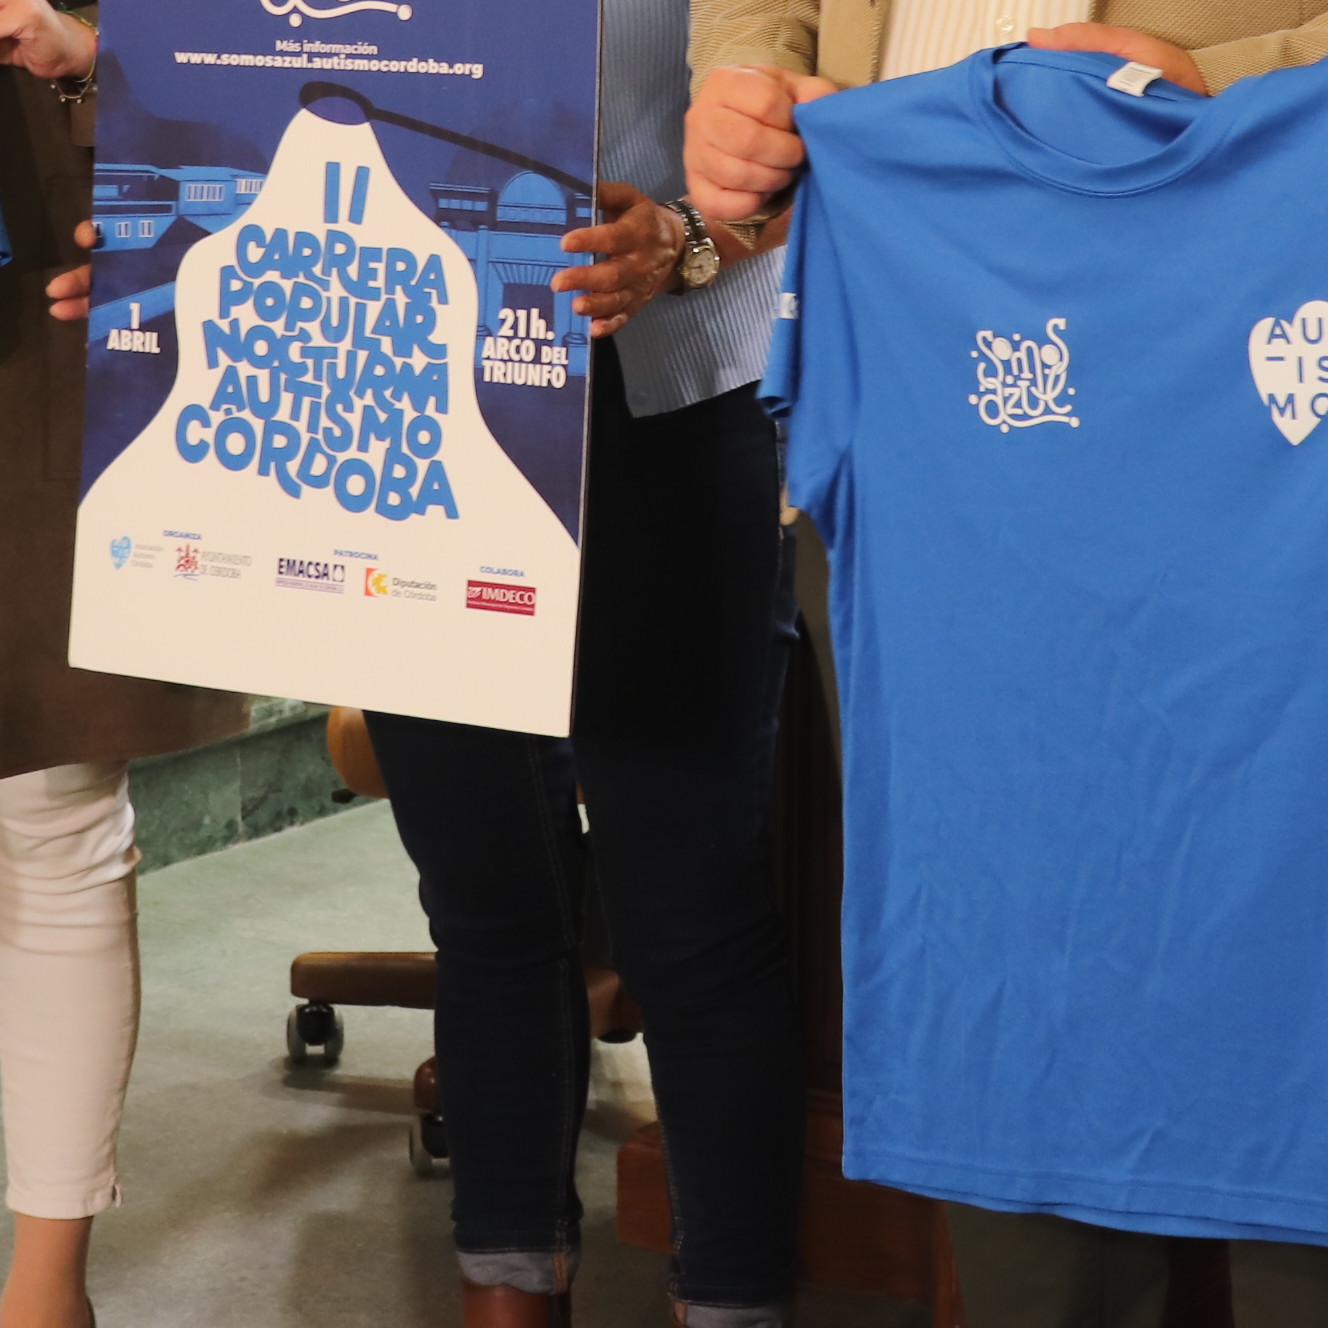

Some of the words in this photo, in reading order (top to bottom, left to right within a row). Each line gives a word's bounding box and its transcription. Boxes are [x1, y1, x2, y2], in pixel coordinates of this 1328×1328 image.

[275, 40, 302, 53] Más
[303, 40, 378, 55] información
[174, 50, 484, 79] www.somosazul.autismocordoba.org
[324, 161, 370, 224] II
[236, 224, 449, 305] CARRERA
[128, 302, 141, 329] 1
[219, 265, 447, 360] POPULAR
[497, 307, 556, 341] 21h.
[106, 328, 161, 354] ABRIL
[1266, 317, 1322, 345] AU
[481, 336, 536, 362] ARCO
[540, 345, 569, 365] DEL
[202, 318, 449, 414] NOCTURNA
[481, 359, 567, 389] TRIUNFO
[209, 365, 442, 459] AUTISMO
[277, 557, 331, 581] EMACSA
[333, 549, 379, 561] PATROCINA
[391, 577, 438, 591] Diputación
[480, 566, 525, 578] COLABORA
[481, 587, 536, 605] IMDECO
